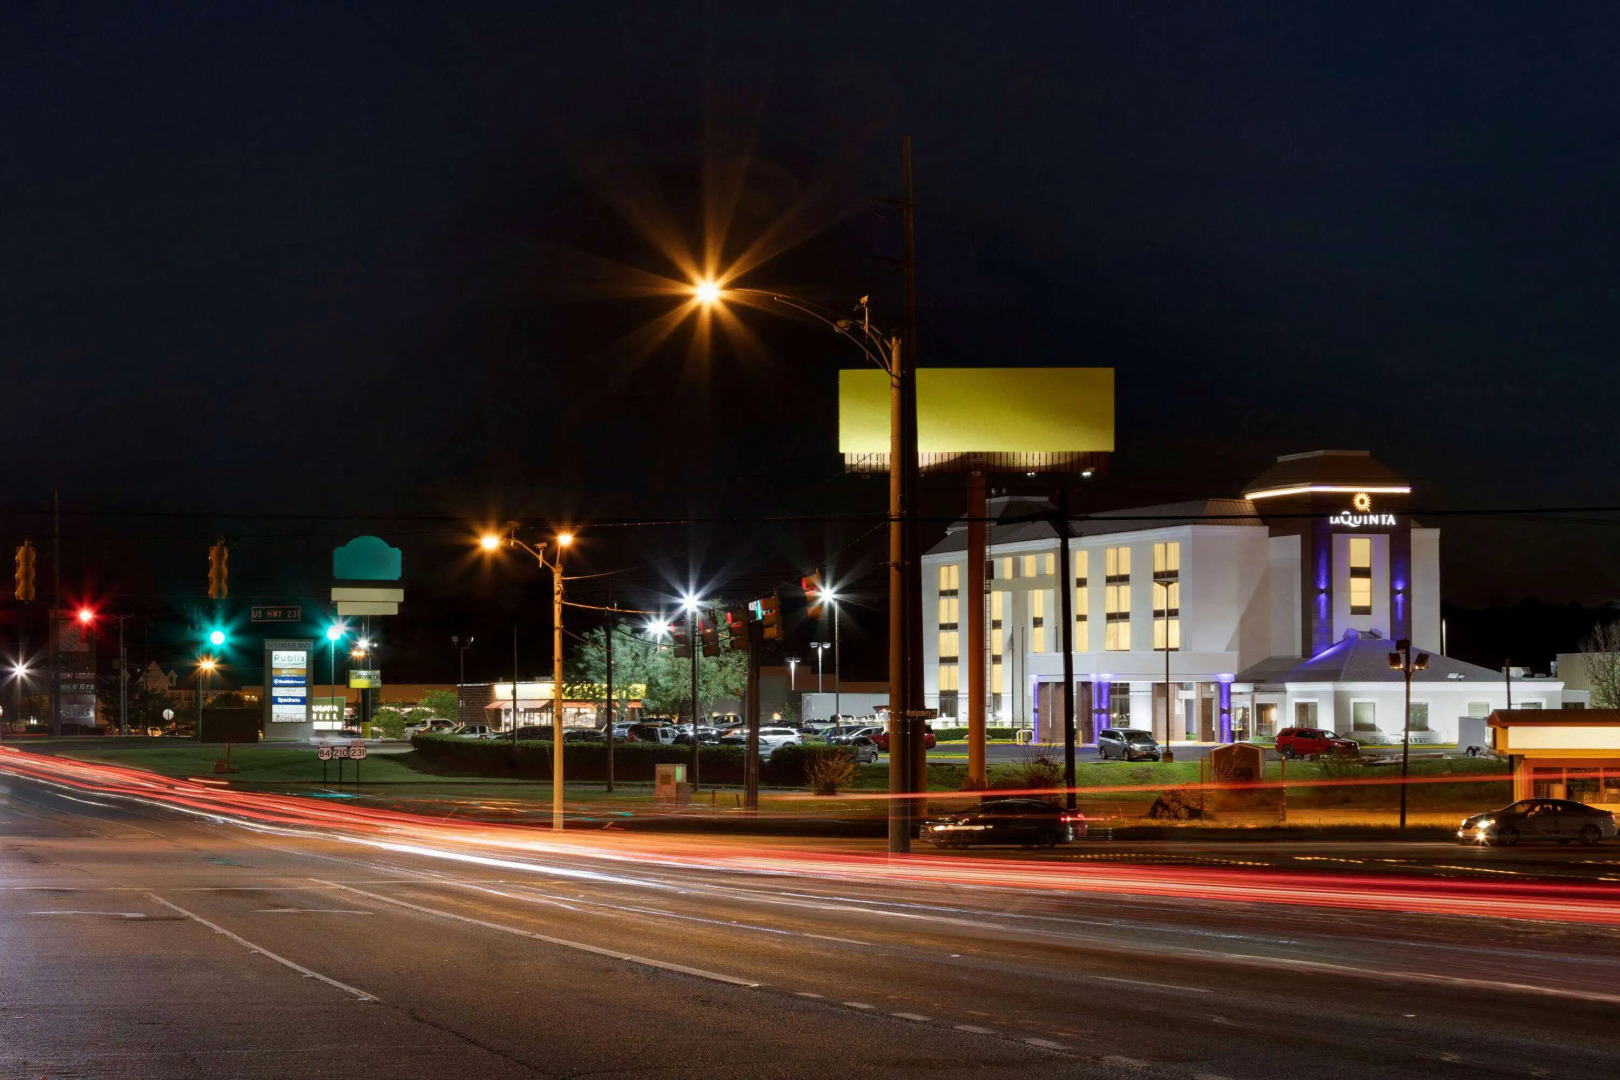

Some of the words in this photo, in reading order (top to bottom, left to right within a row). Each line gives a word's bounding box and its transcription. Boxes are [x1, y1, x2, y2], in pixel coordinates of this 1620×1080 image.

[1340, 510, 1397, 528] QUINTA
[252, 610, 263, 619] US
[267, 610, 283, 619] HWY
[274, 654, 305, 662] Publix
[319, 749, 330, 758] 84
[333, 749, 348, 757] 210
[351, 748, 365, 757] 231
